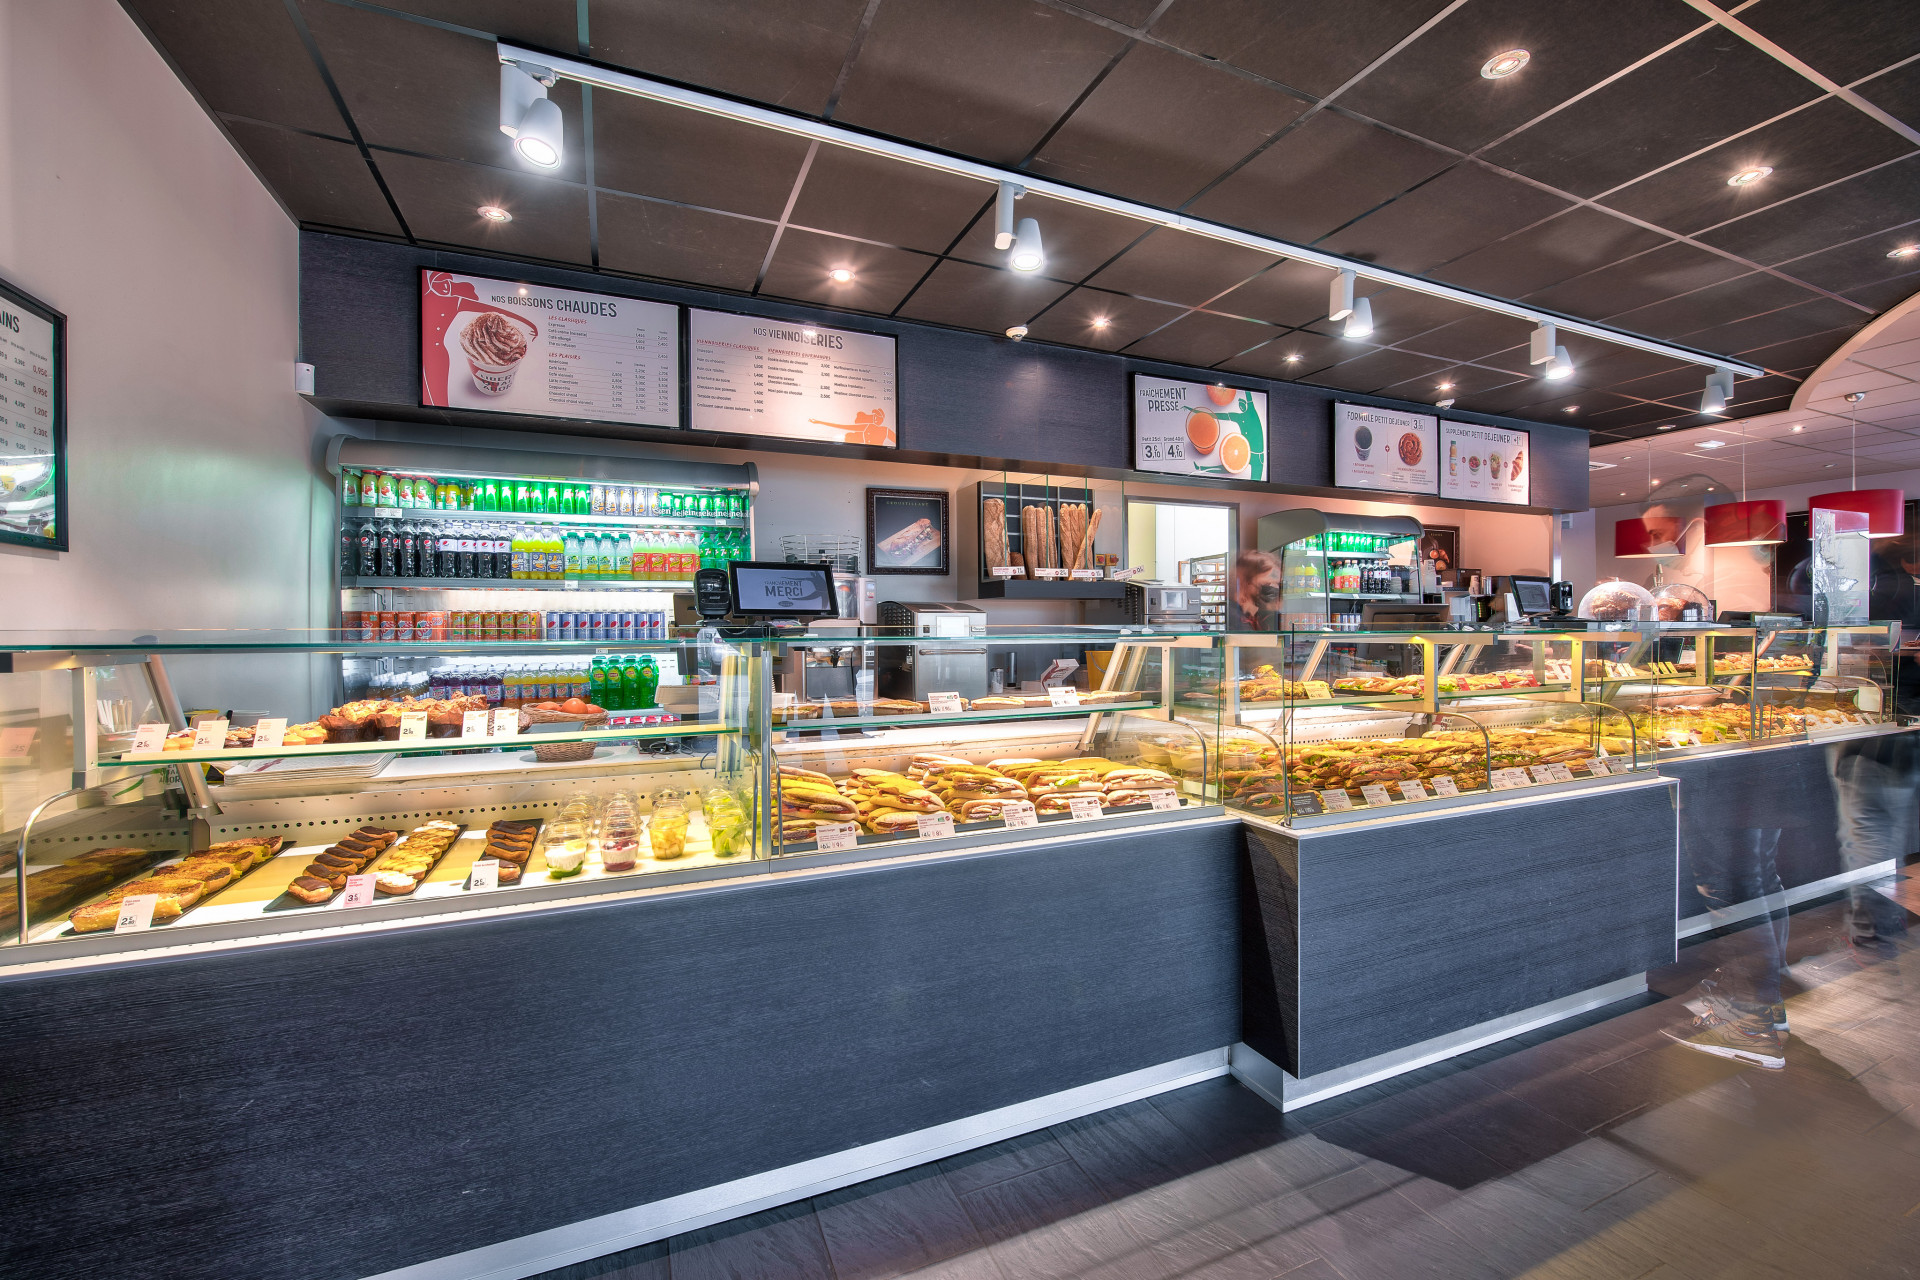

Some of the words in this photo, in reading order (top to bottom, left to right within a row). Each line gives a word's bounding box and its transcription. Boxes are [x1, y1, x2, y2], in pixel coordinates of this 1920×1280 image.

[491, 295, 506, 304] NOS
[507, 296, 554, 310] BOISSONS
[556, 300, 617, 318] CHAUDES
[0, 310, 20, 334] INS
[558, 316, 588, 325] CLASSIQUES
[753, 327, 767, 337] NOS
[768, 329, 843, 350] VIENNOISERIES
[559, 353, 581, 361] PLAISIRS
[1347, 411, 1374, 423] FORMULE
[1374, 415, 1388, 424] PETIT
[1471, 430, 1484, 440] PETIT
[764, 585, 803, 597] MERCI
